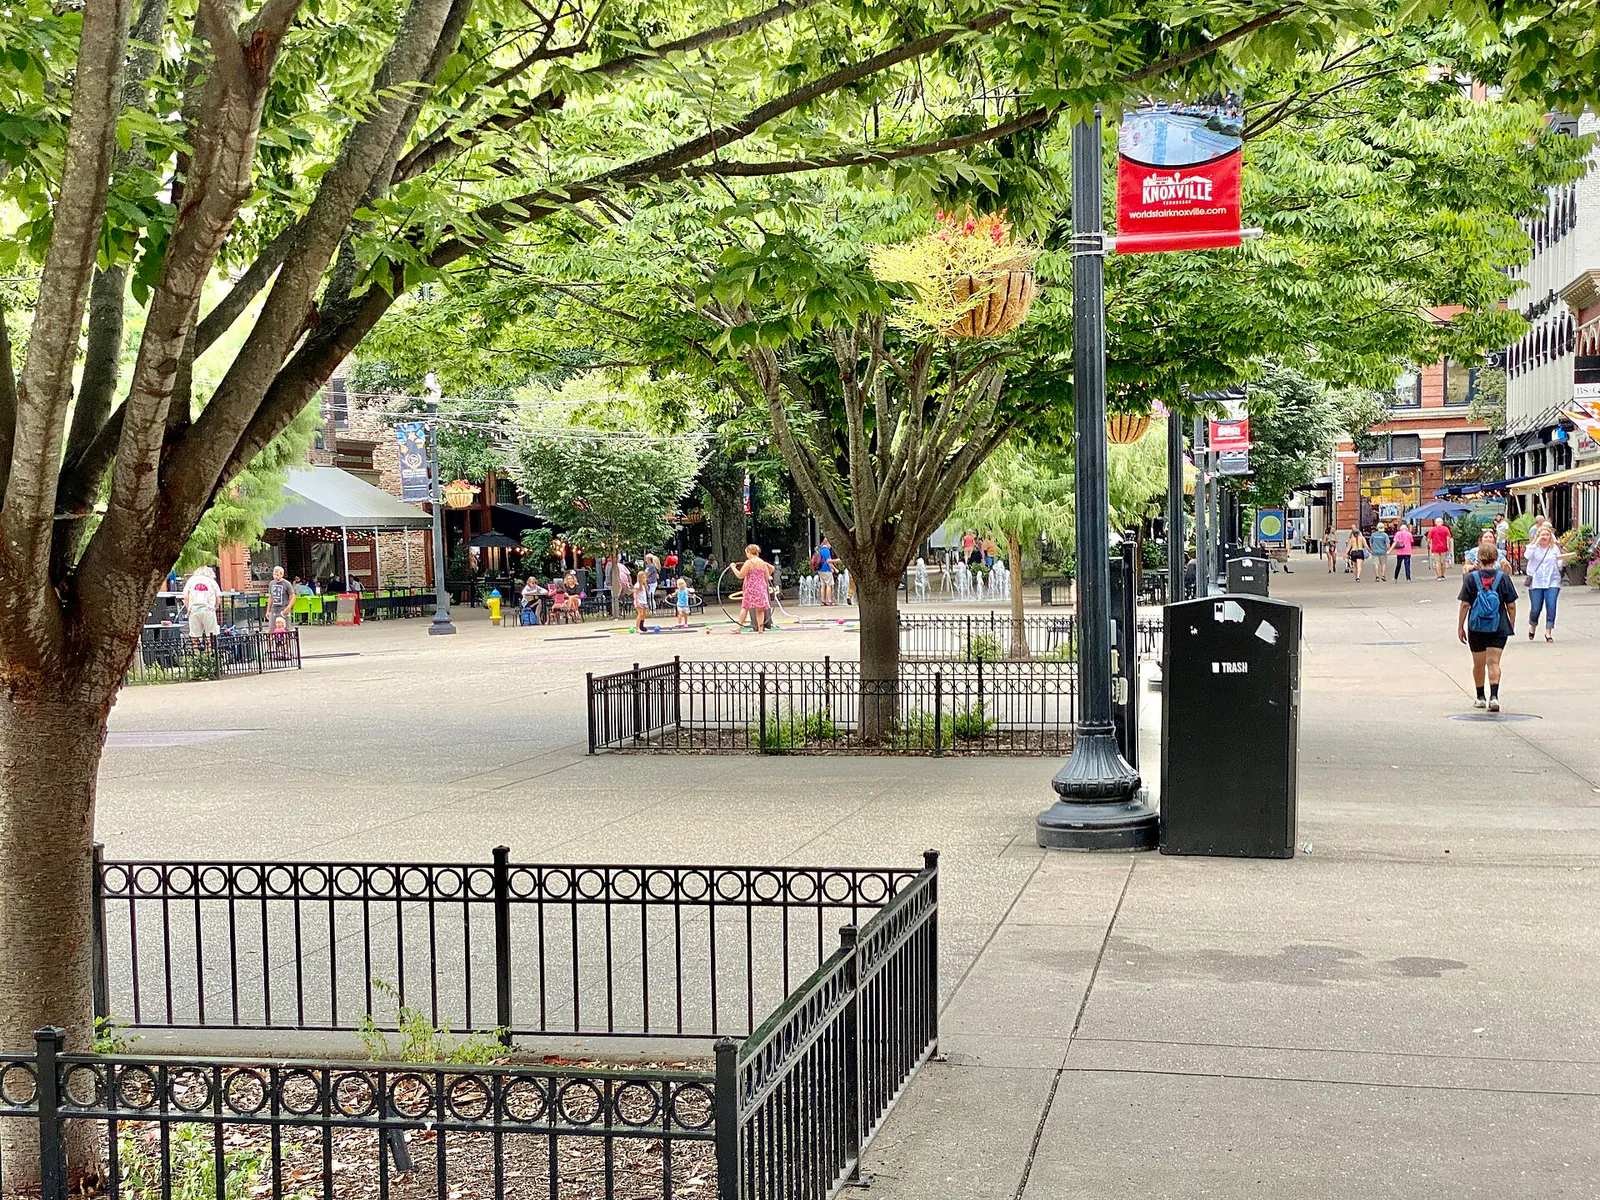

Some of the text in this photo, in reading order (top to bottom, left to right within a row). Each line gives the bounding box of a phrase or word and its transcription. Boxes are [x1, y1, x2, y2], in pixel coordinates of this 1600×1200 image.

[1142, 184, 1212, 204] KNOXVILLE
[1129, 207, 1227, 218] worldsfairknoxville.com
[1221, 662, 1247, 673] TRASH
